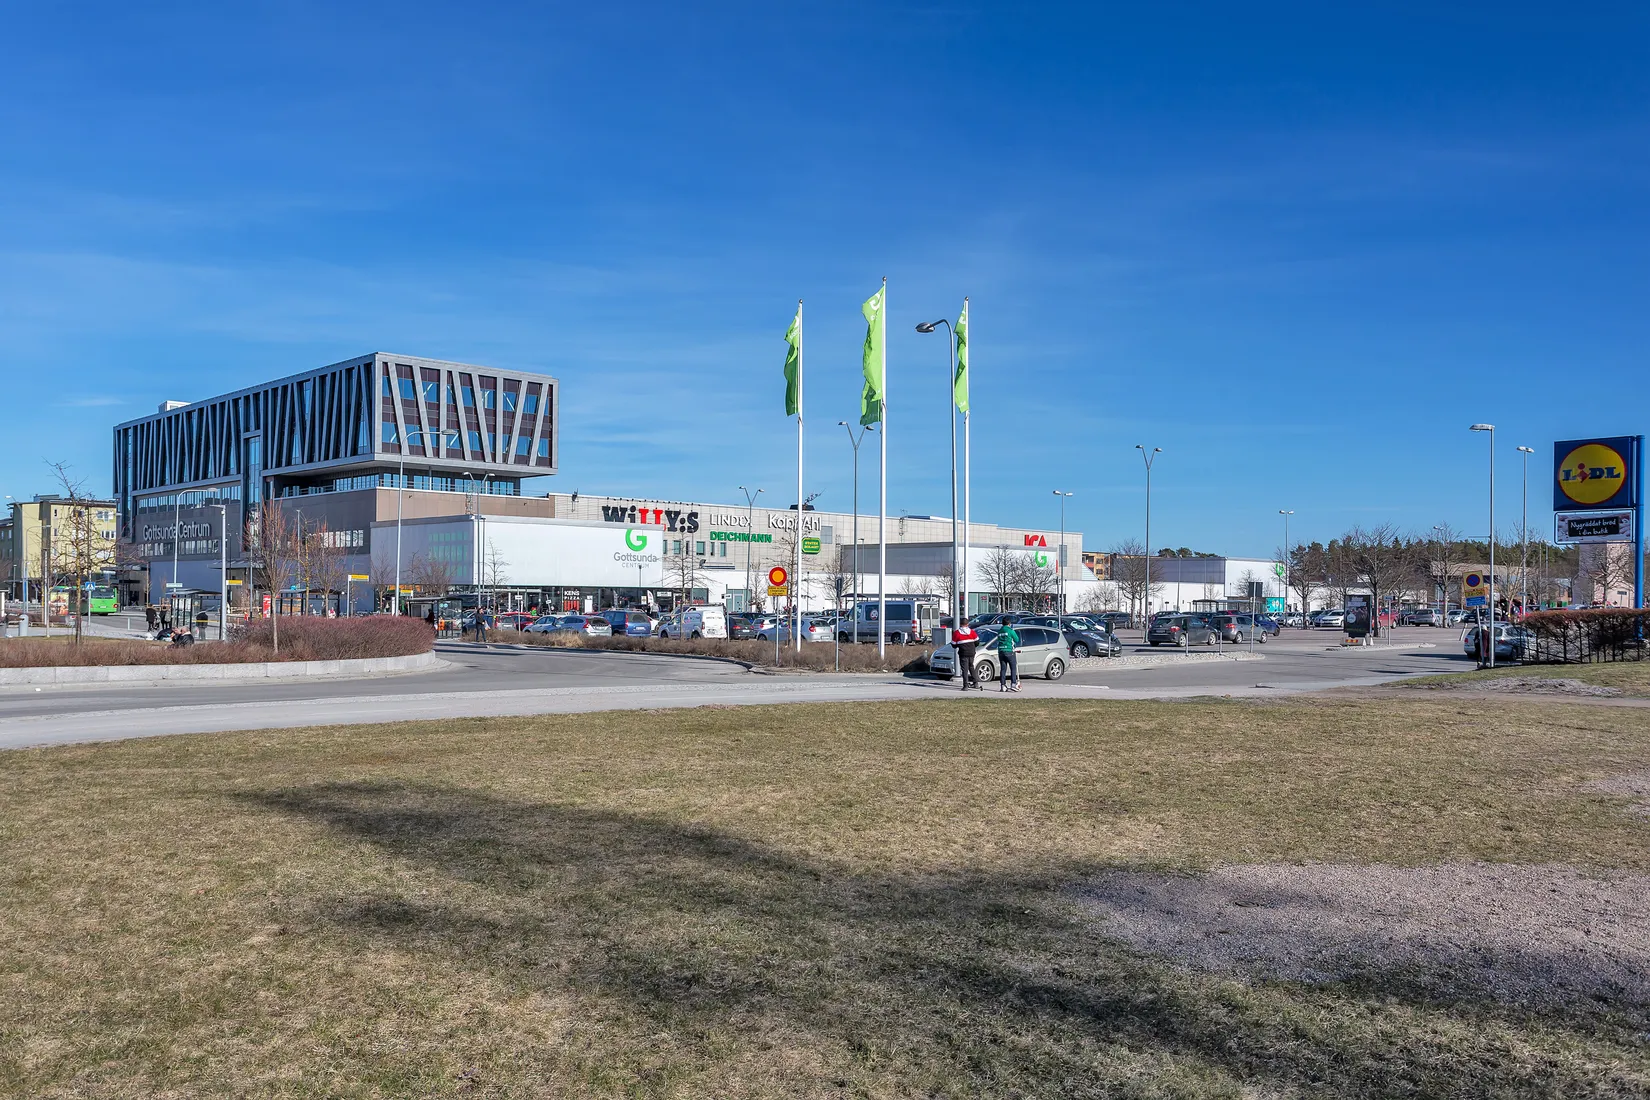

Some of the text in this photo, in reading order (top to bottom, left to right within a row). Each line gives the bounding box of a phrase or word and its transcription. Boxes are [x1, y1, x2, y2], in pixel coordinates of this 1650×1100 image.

[710, 514, 752, 527] LINDEX
[143, 521, 210, 540] Gottsunda Centrum
[710, 531, 772, 543] DEICHMANN
[1024, 534, 1047, 547] ICA
[613, 551, 658, 562] Gottsunda
